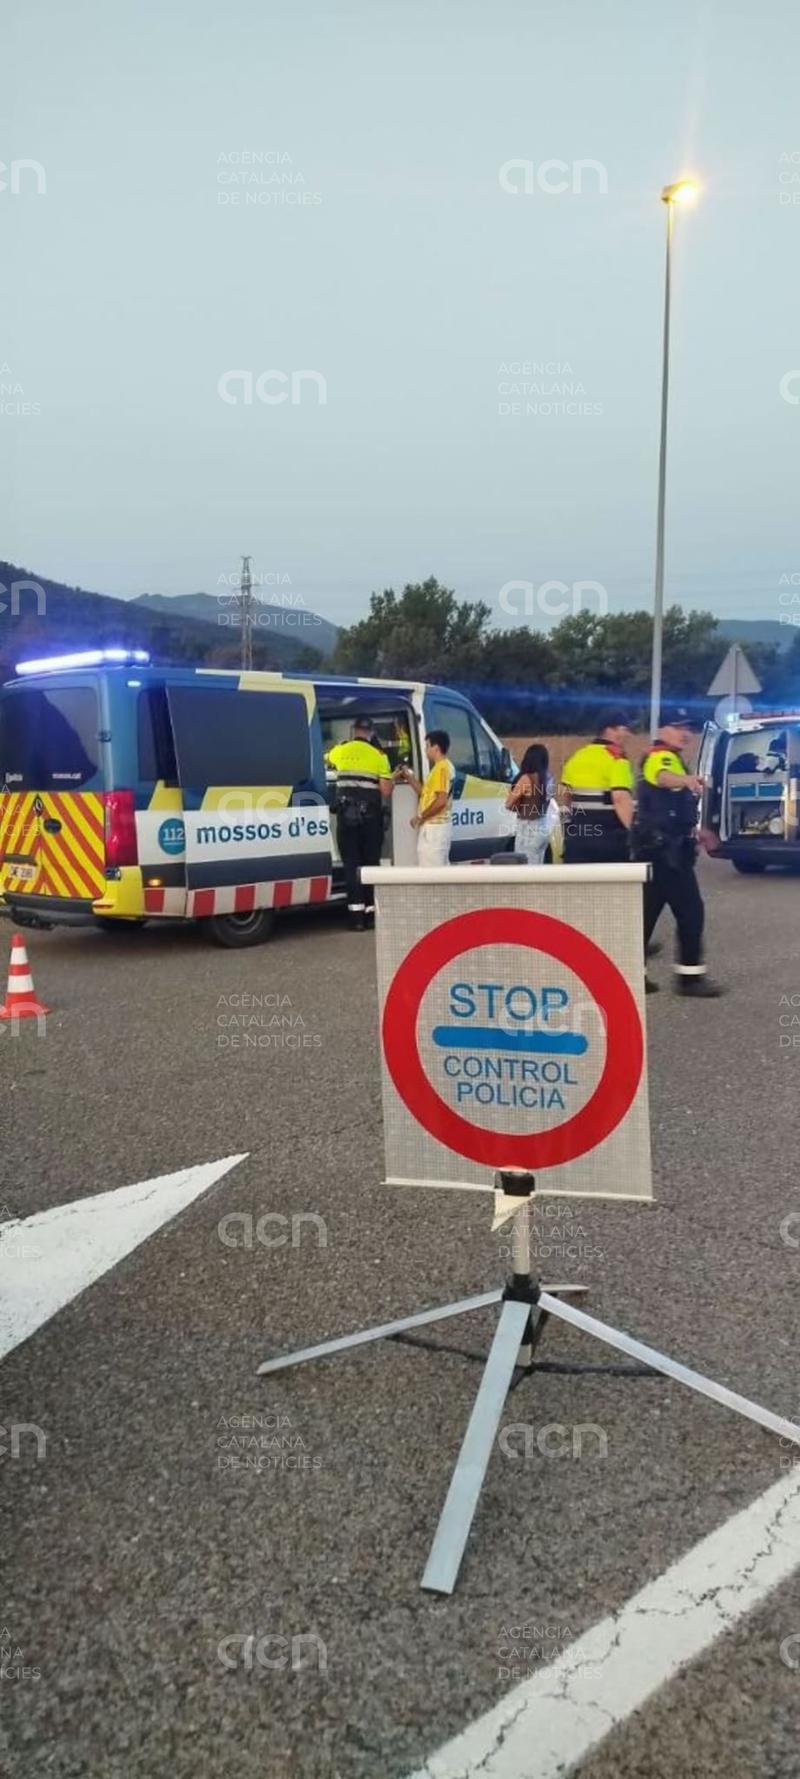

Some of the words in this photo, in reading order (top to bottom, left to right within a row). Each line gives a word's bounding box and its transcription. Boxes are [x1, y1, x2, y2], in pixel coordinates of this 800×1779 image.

[451, 808, 484, 826] adra
[164, 828, 184, 840] 112
[196, 823, 281, 844] mossos
[450, 983, 569, 1021] STOP
[444, 1056, 578, 1085] CONTROL
[457, 1082, 565, 1110] POLICIA
